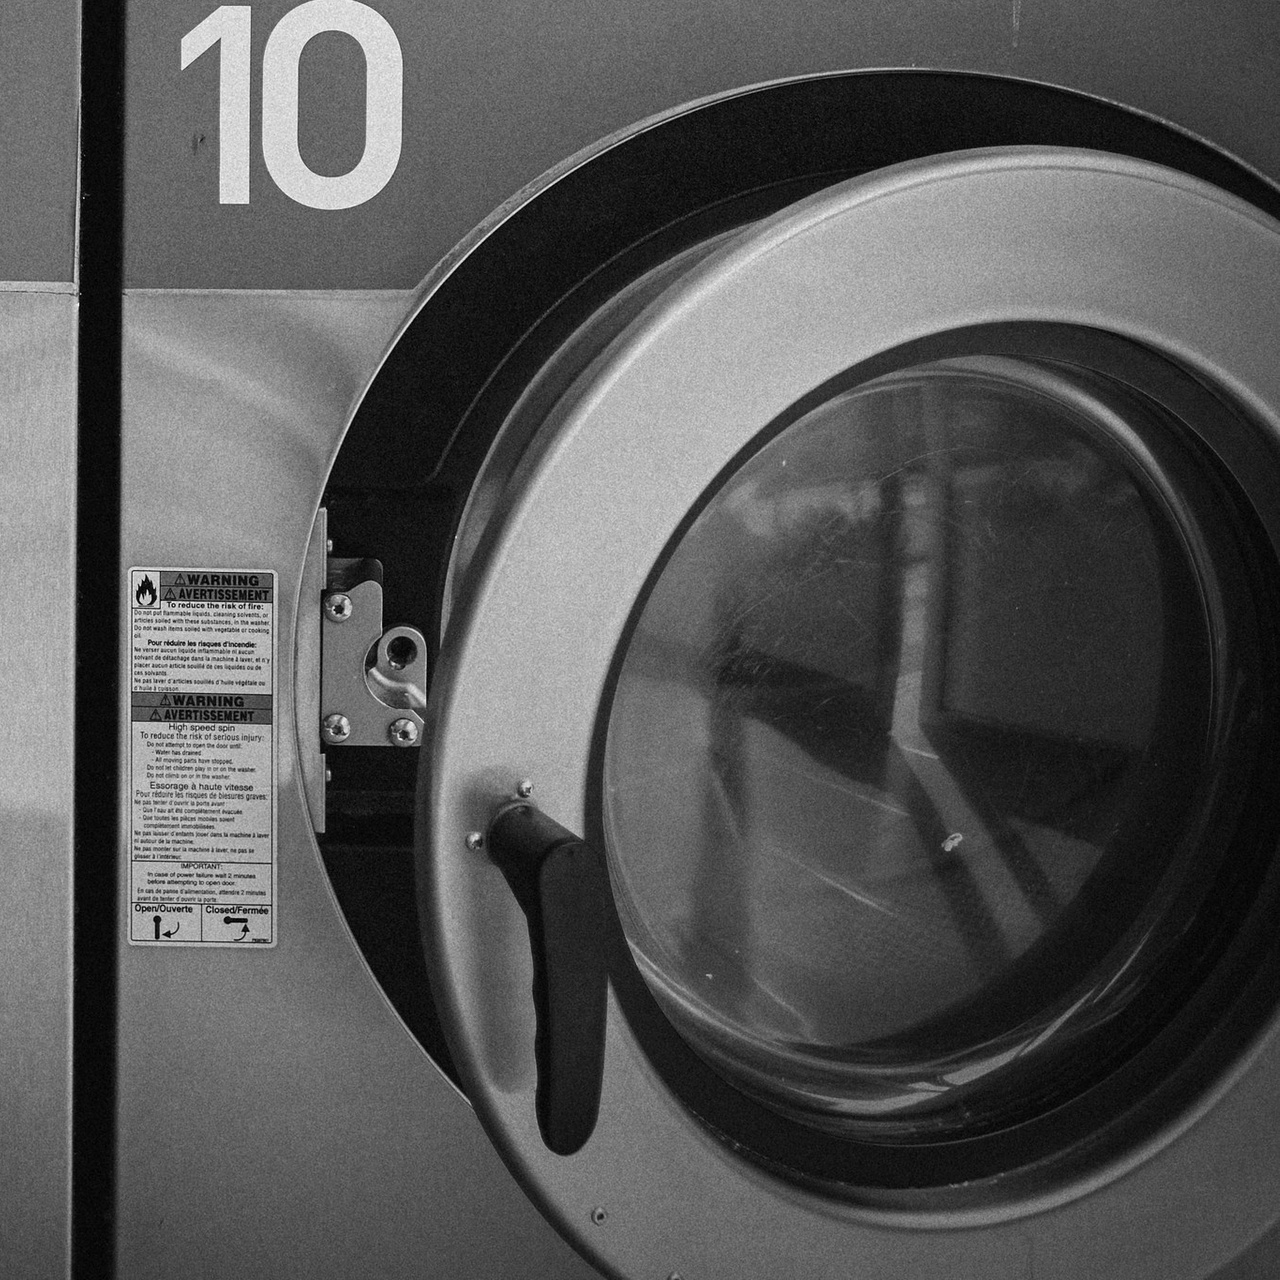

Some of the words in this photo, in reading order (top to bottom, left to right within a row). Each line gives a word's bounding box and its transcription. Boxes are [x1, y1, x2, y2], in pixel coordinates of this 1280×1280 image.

[186, 574, 259, 586] WARNING
[179, 589, 269, 601] AVERTISSEMENT
[198, 640, 221, 648] risques
[172, 695, 244, 707] WARNING
[164, 709, 254, 722] AVERTISSEMENT
[168, 723, 187, 733] High
[190, 723, 215, 733] speed
[218, 724, 235, 733] spin
[140, 731, 148, 739] To
[189, 732, 202, 740] risk
[213, 733, 239, 741] serious
[149, 782, 188, 792] Essorage
[190, 782, 196, 790] à
[224, 783, 253, 791] vitesse
[151, 790, 173, 798] réduire
[185, 791, 207, 800] risques
[134, 903, 193, 913] Open/Ouverte
[205, 905, 268, 914] Closed/Fermée
